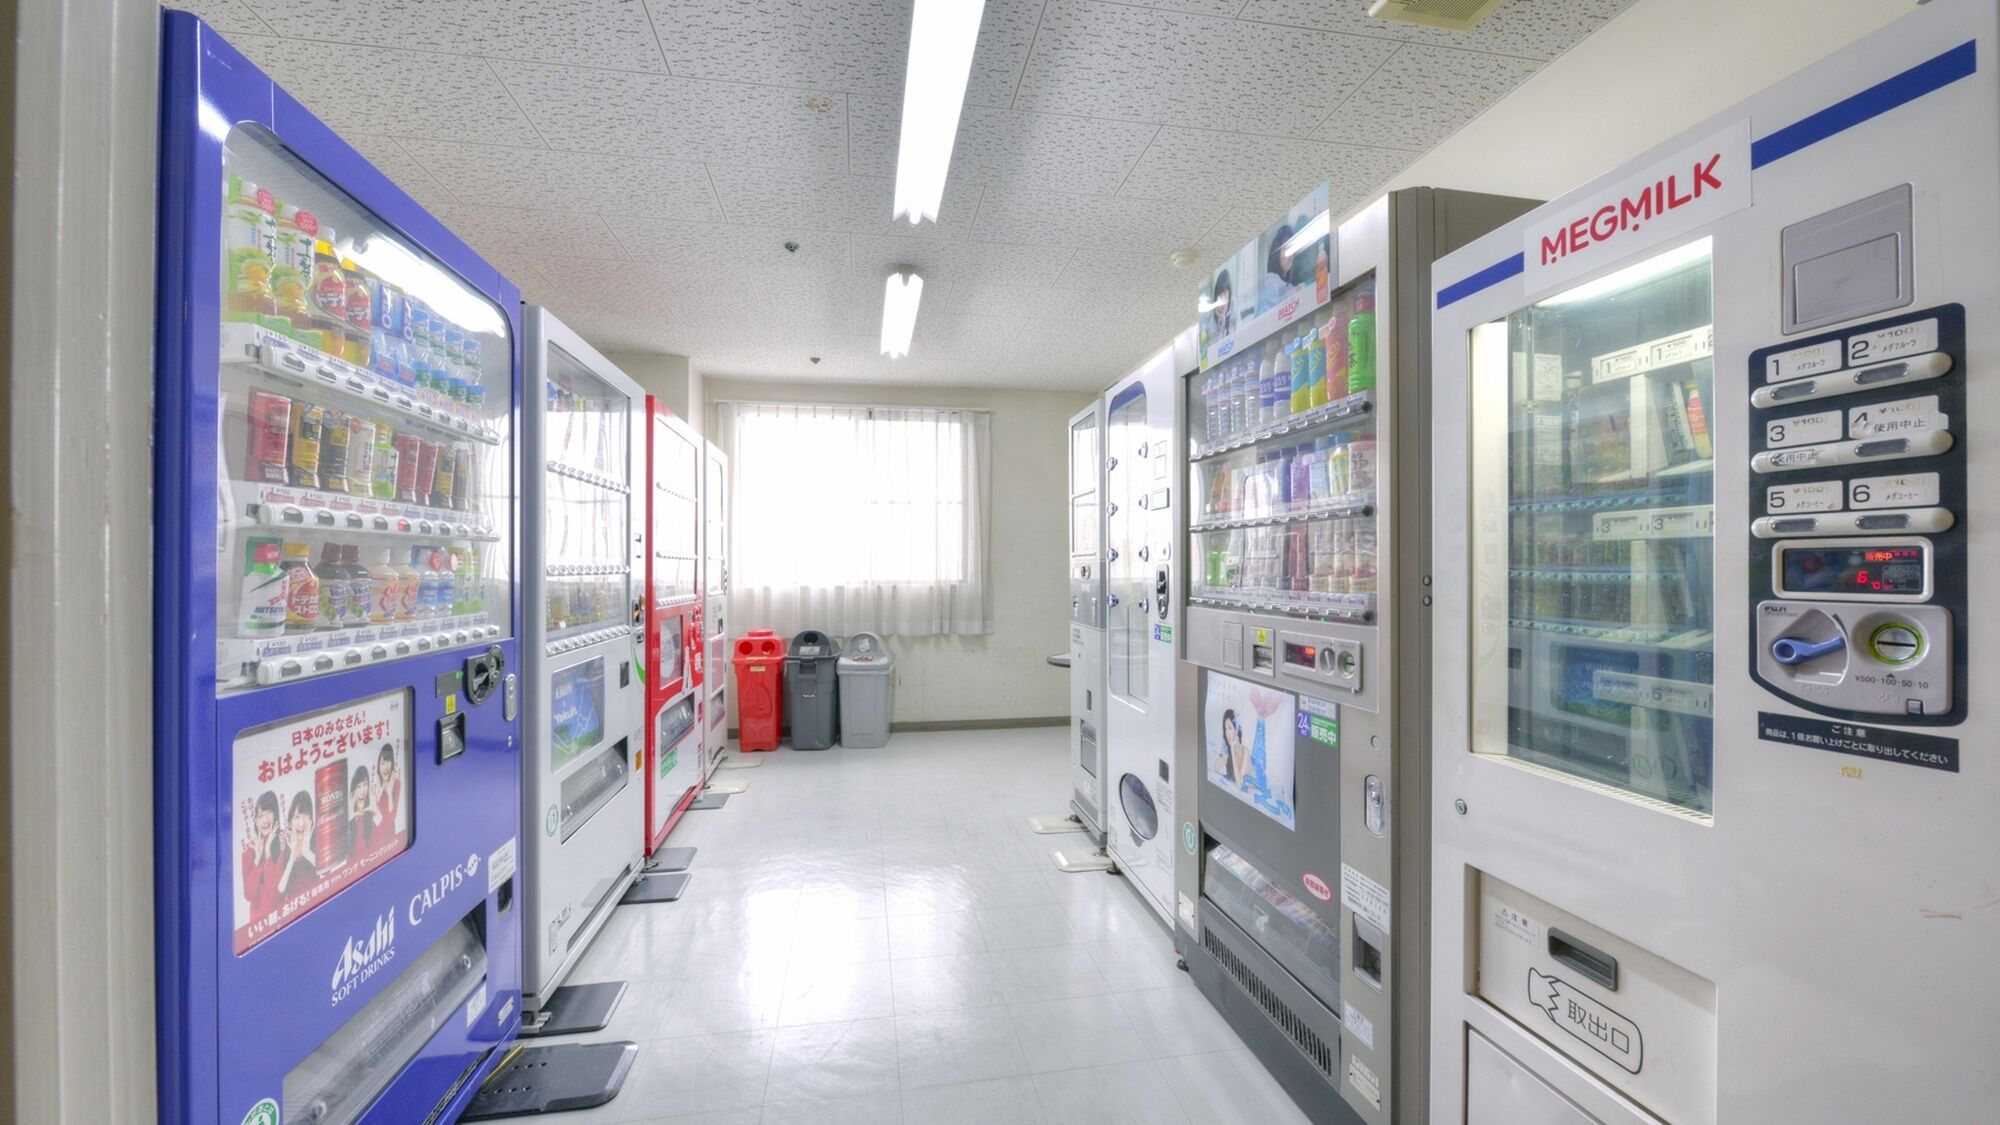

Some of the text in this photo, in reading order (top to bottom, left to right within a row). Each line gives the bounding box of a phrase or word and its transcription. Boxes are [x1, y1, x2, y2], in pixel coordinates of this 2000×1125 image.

[1541, 153, 1723, 266] MEGMILK
[1878, 328, 1915, 339] ¥100
[1851, 340, 1870, 360] 2
[1772, 360, 1780, 376] 1
[1770, 425, 1786, 443] 3
[1874, 418, 1926, 434] 使用中止
[1770, 491, 1786, 509] 5
[1853, 484, 1871, 503] 6
[1601, 521, 1611, 534] 3
[1655, 517, 1665, 531] 3
[1857, 570, 1869, 585] 6
[258, 720, 391, 784] おはようございます!
[408, 864, 464, 927] CALPIS
[331, 905, 395, 991] Asahi
[331, 946, 396, 1008] SOFT DRINKS
[1567, 998, 1630, 1055] 取出口
